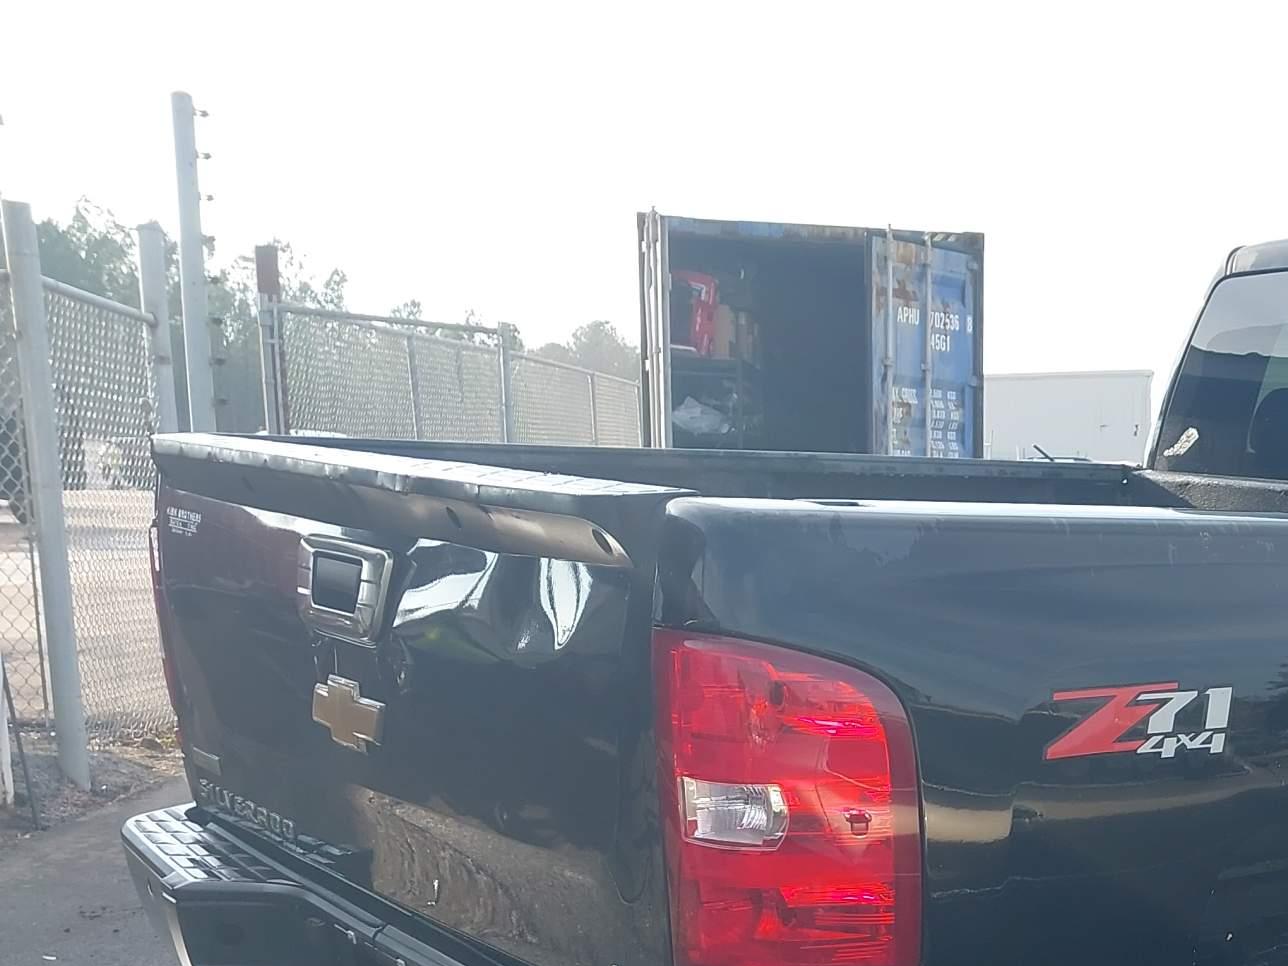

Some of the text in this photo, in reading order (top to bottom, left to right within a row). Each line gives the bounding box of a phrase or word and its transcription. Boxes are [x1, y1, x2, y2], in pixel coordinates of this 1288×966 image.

[897, 307, 920, 326] APHU
[1047, 681, 1233, 760] Z71
[199, 778, 296, 841] SILVERADO
